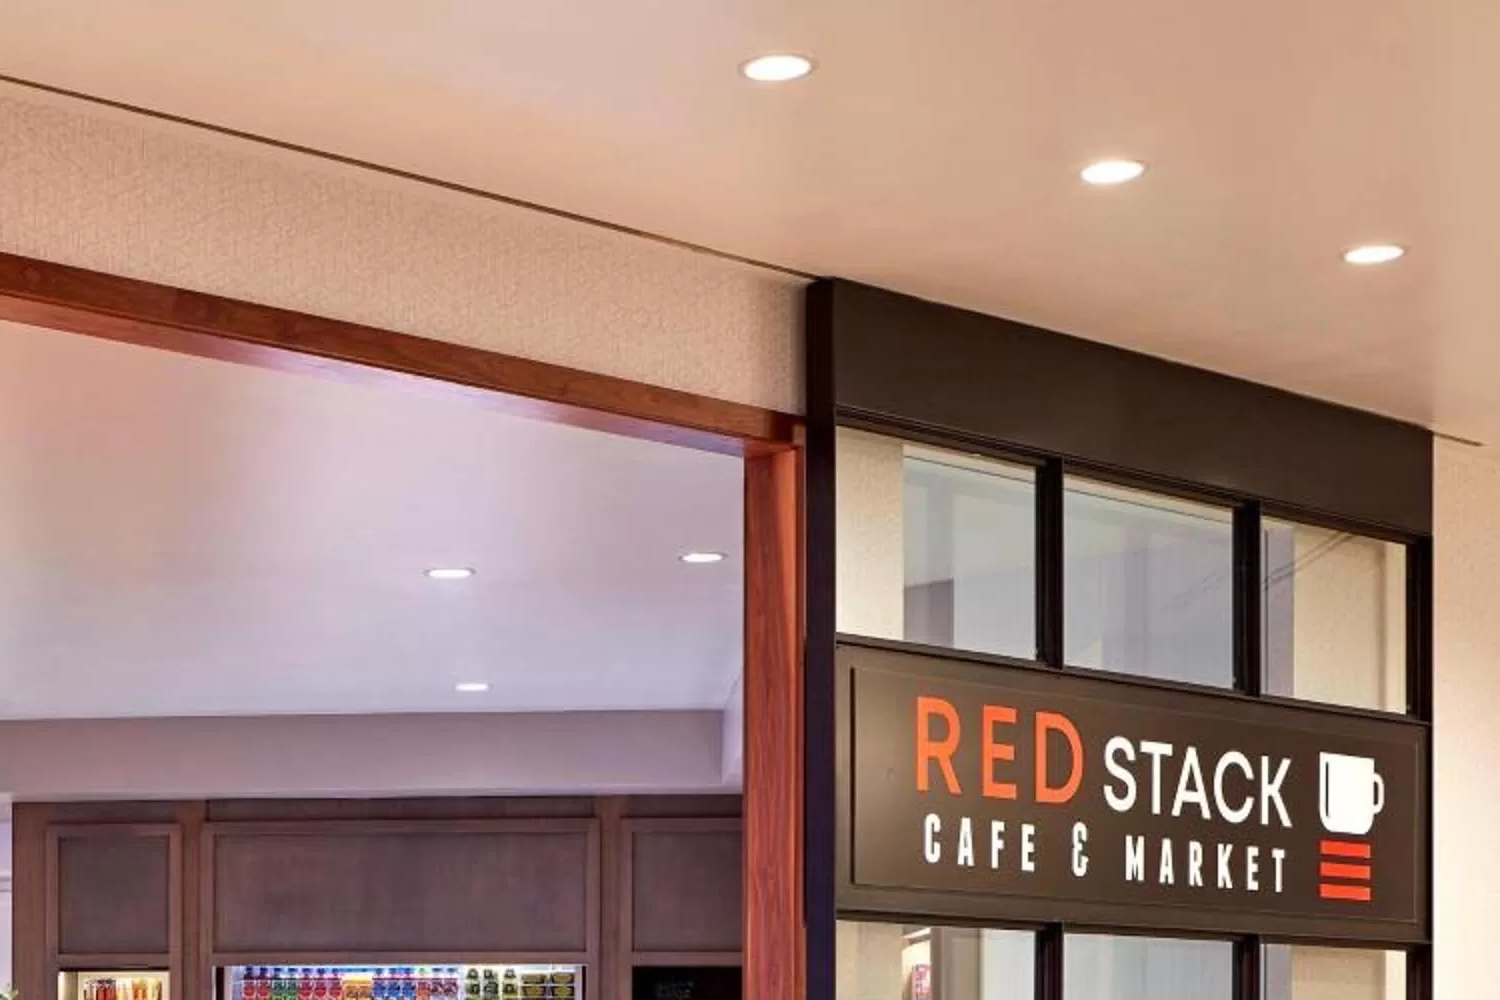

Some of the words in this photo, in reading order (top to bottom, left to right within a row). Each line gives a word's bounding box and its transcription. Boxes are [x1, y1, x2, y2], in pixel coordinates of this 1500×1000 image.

[914, 695, 1084, 804] RED
[1103, 736, 1292, 827] STACK
[924, 813, 1035, 872] CAFE
[1072, 821, 1089, 877] &
[1125, 835, 1286, 893] MARKET
